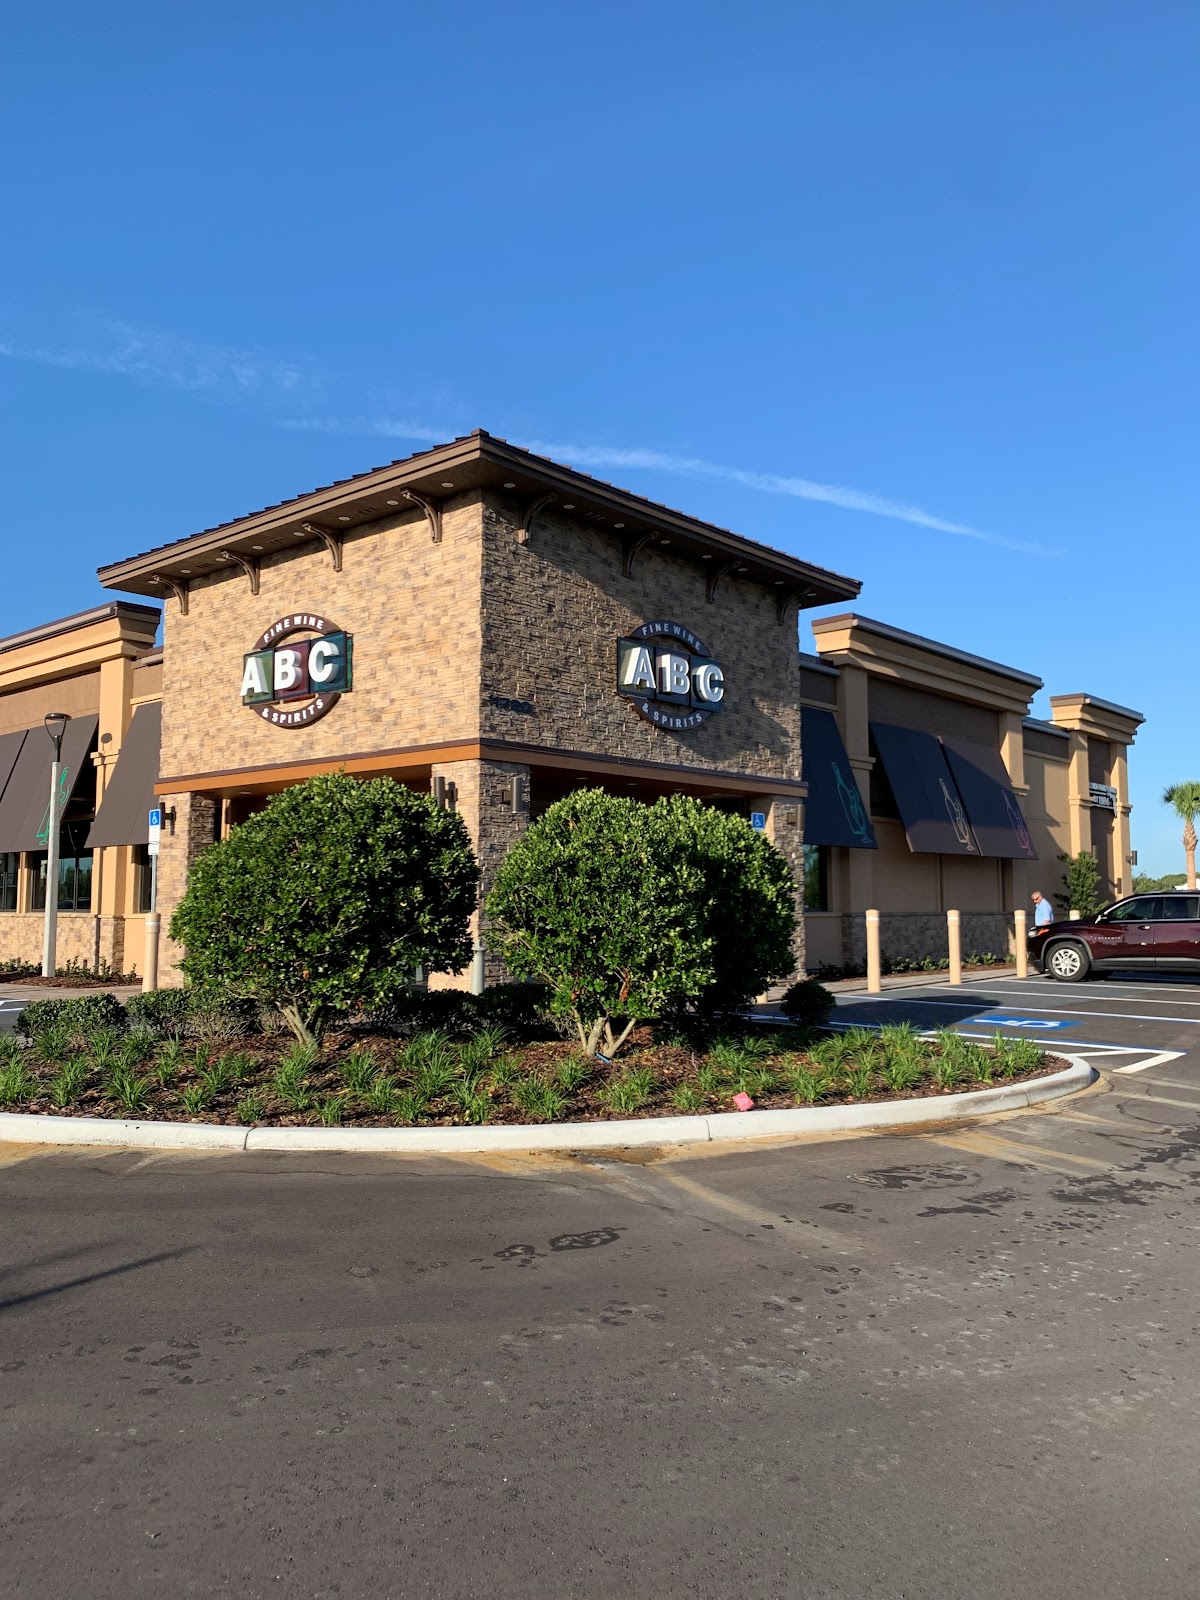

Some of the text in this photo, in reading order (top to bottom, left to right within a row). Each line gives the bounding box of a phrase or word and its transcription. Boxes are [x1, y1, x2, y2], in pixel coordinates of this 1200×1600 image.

[263, 615, 324, 643] FINE WINE
[641, 623, 701, 651] FINE WINE
[240, 640, 339, 697] ABC
[623, 647, 724, 702] ABC
[261, 698, 324, 724] & SPIRITS
[641, 702, 702, 728] & SPIRITS
